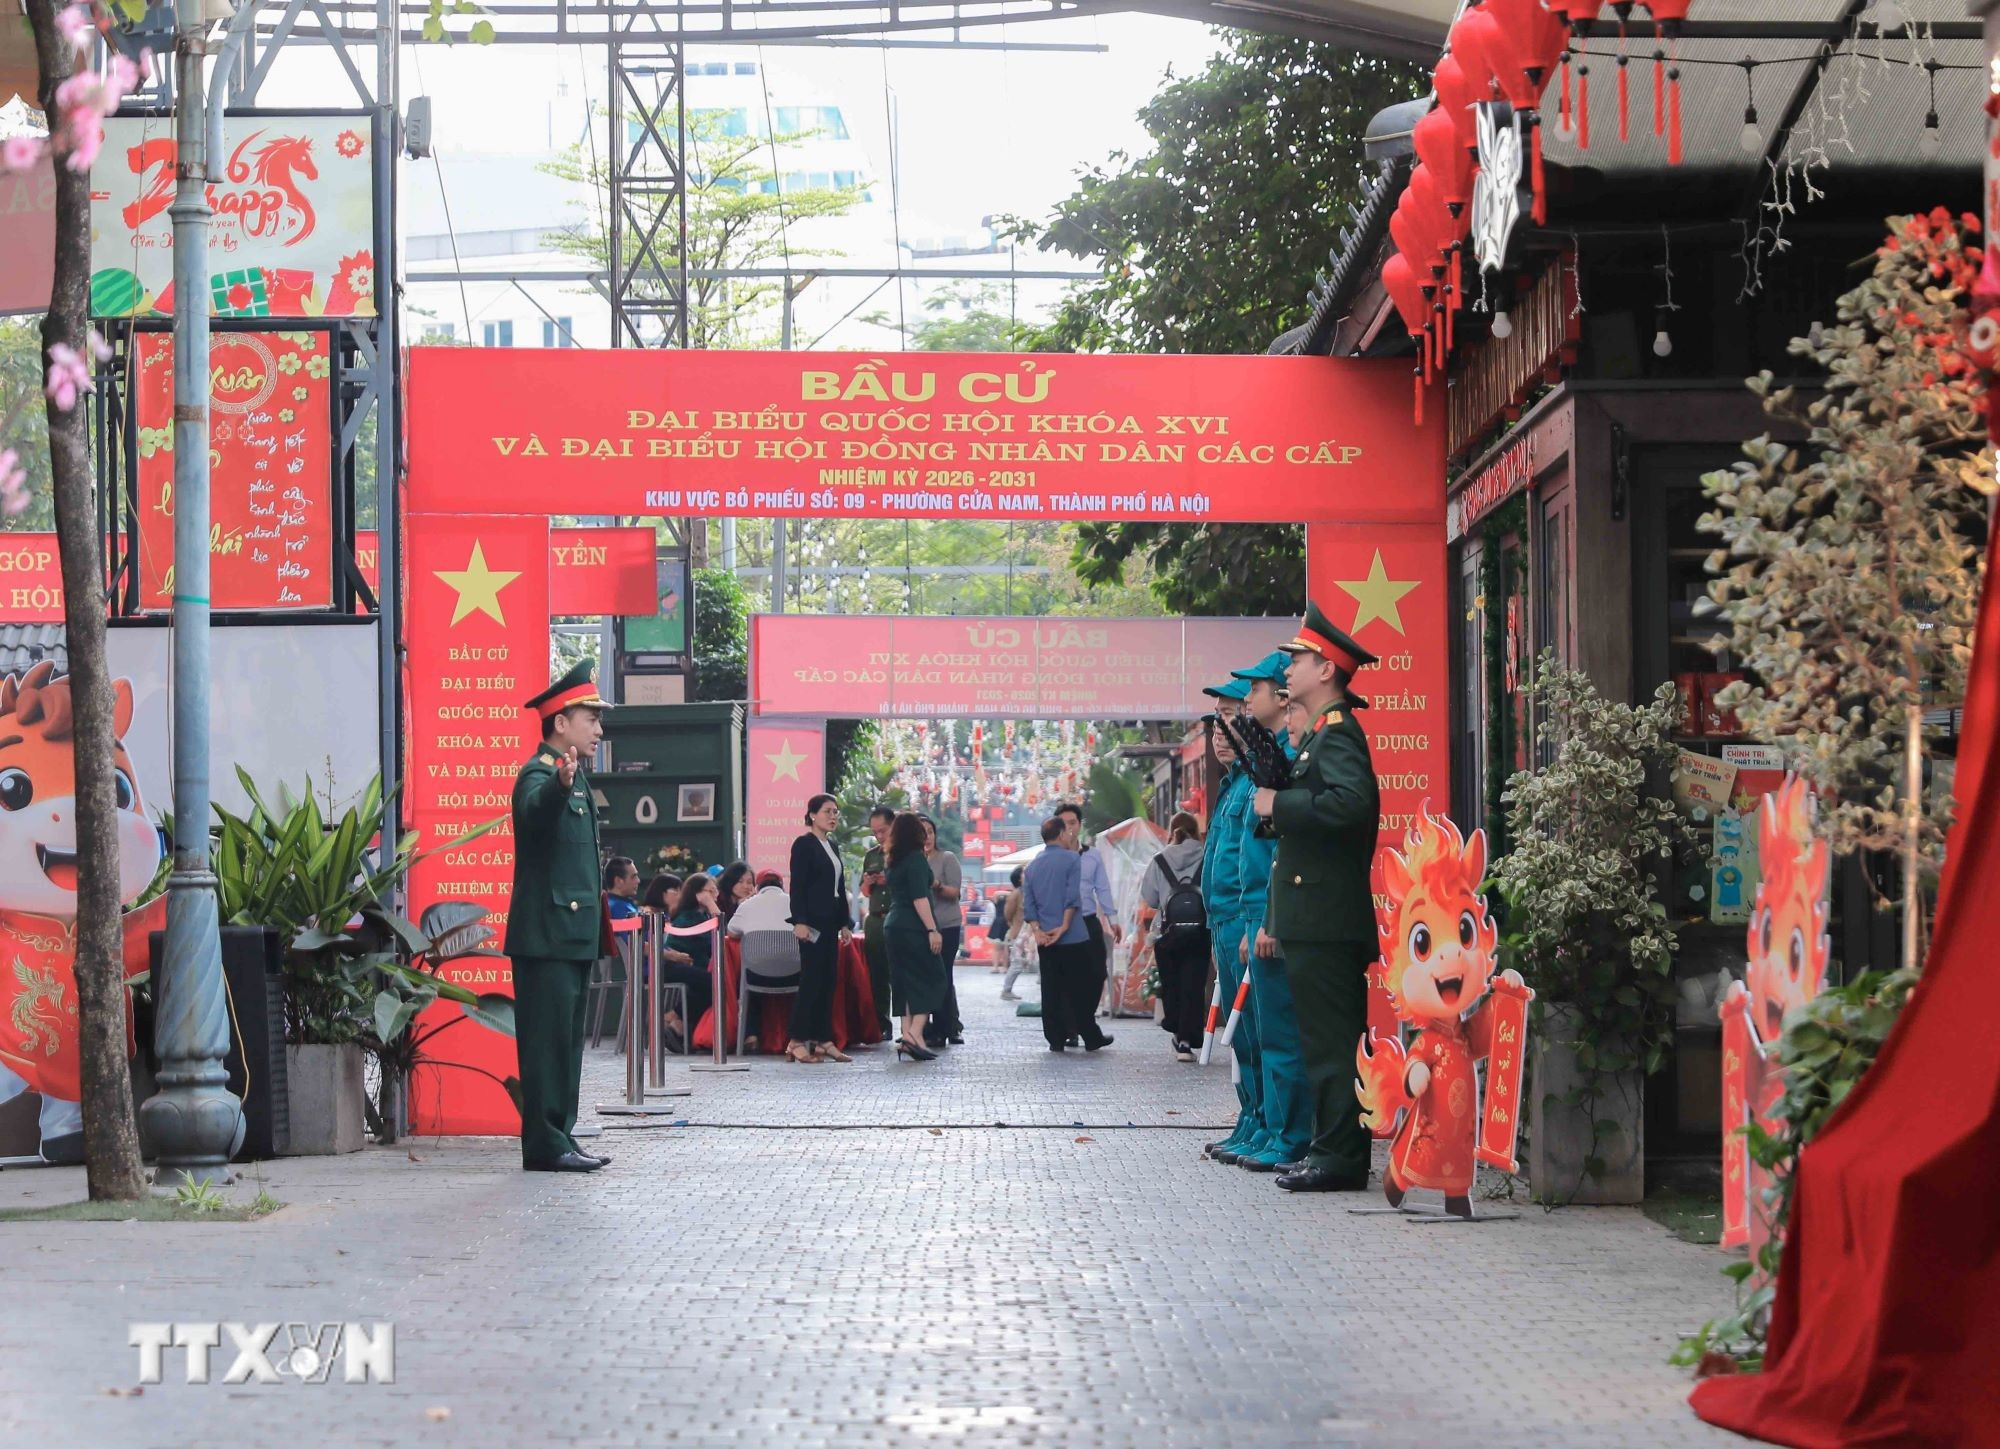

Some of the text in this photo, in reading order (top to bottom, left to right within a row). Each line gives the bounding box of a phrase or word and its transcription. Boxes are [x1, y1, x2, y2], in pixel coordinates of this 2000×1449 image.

[217, 220, 236, 229] year
[802, 358, 1057, 403] BẦU CỬ
[627, 404, 1230, 436] ĐẠI BIỂU QUỐC HỘI KHÓA XVI
[492, 432, 1363, 465] VÀ ĐẠI BIỂU HỘI ĐỒNG NHÂN DÂN CÁC CẤP
[819, 468, 886, 488] NHIỆM
[893, 468, 918, 486] KỲ
[925, 471, 974, 487] 2026
[989, 472, 1036, 487] 2031
[646, 490, 682, 507] KHU
[686, 490, 720, 510] VỰC
[725, 487, 747, 508] BỎ
[754, 488, 806, 508] PHIẾU
[810, 487, 839, 508] SỐ:
[843, 493, 865, 509] 09
[882, 490, 955, 510] PHƯỜNG
[958, 489, 993, 510] CỬA
[998, 495, 1044, 513] NAM,
[1050, 490, 1105, 511] THÀNH
[1111, 490, 1147, 511] PHỐ
[1151, 492, 1174, 512] HÀ
[1179, 493, 1209, 515] NỘI
[10, 584, 61, 612] HỘI
[449, 642, 509, 660] BẦU CỬ
[1388, 650, 1413, 670] CỬ
[441, 673, 515, 691] ĐẠI BIỂU
[1374, 688, 1427, 710] PHẦN
[438, 703, 518, 720] QUỐC HỘI
[437, 733, 520, 748] KHÓA XVI
[1376, 734, 1429, 754] DỰNG
[428, 760, 523, 779] VÀ ĐẠI BIỂ
[1378, 771, 1429, 789] NƯỚC
[437, 790, 468, 808] HỘI
[434, 822, 514, 836] NHÂ DÂ
[445, 849, 513, 865] CÁC CẤP
[437, 880, 493, 897] NHIỆM
[451, 967, 497, 982] TOÀN
